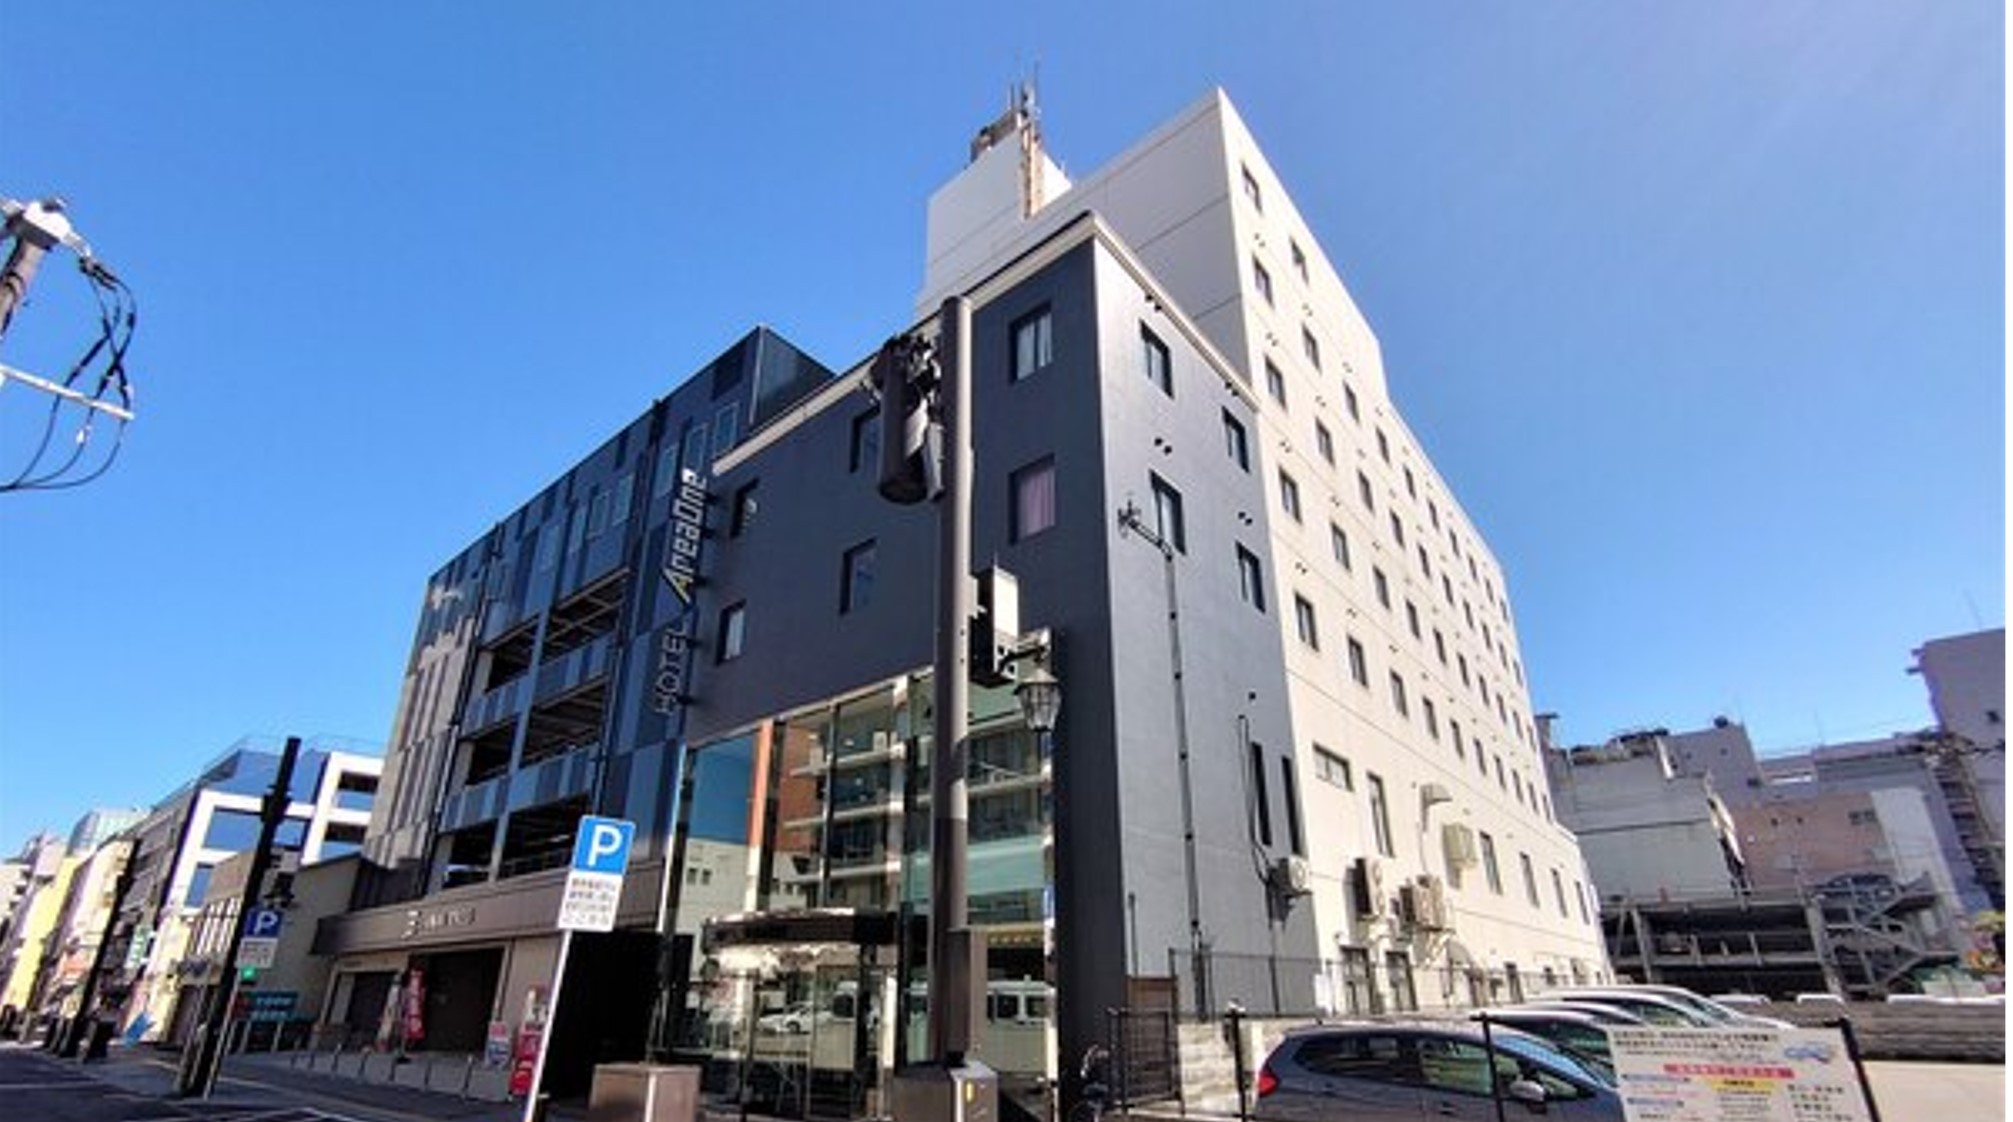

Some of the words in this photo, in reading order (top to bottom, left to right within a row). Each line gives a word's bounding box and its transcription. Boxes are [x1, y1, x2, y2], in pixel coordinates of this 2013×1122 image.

[654, 621, 687, 715] HOTEL
[587, 824, 623, 868] P
[253, 911, 279, 936] P
